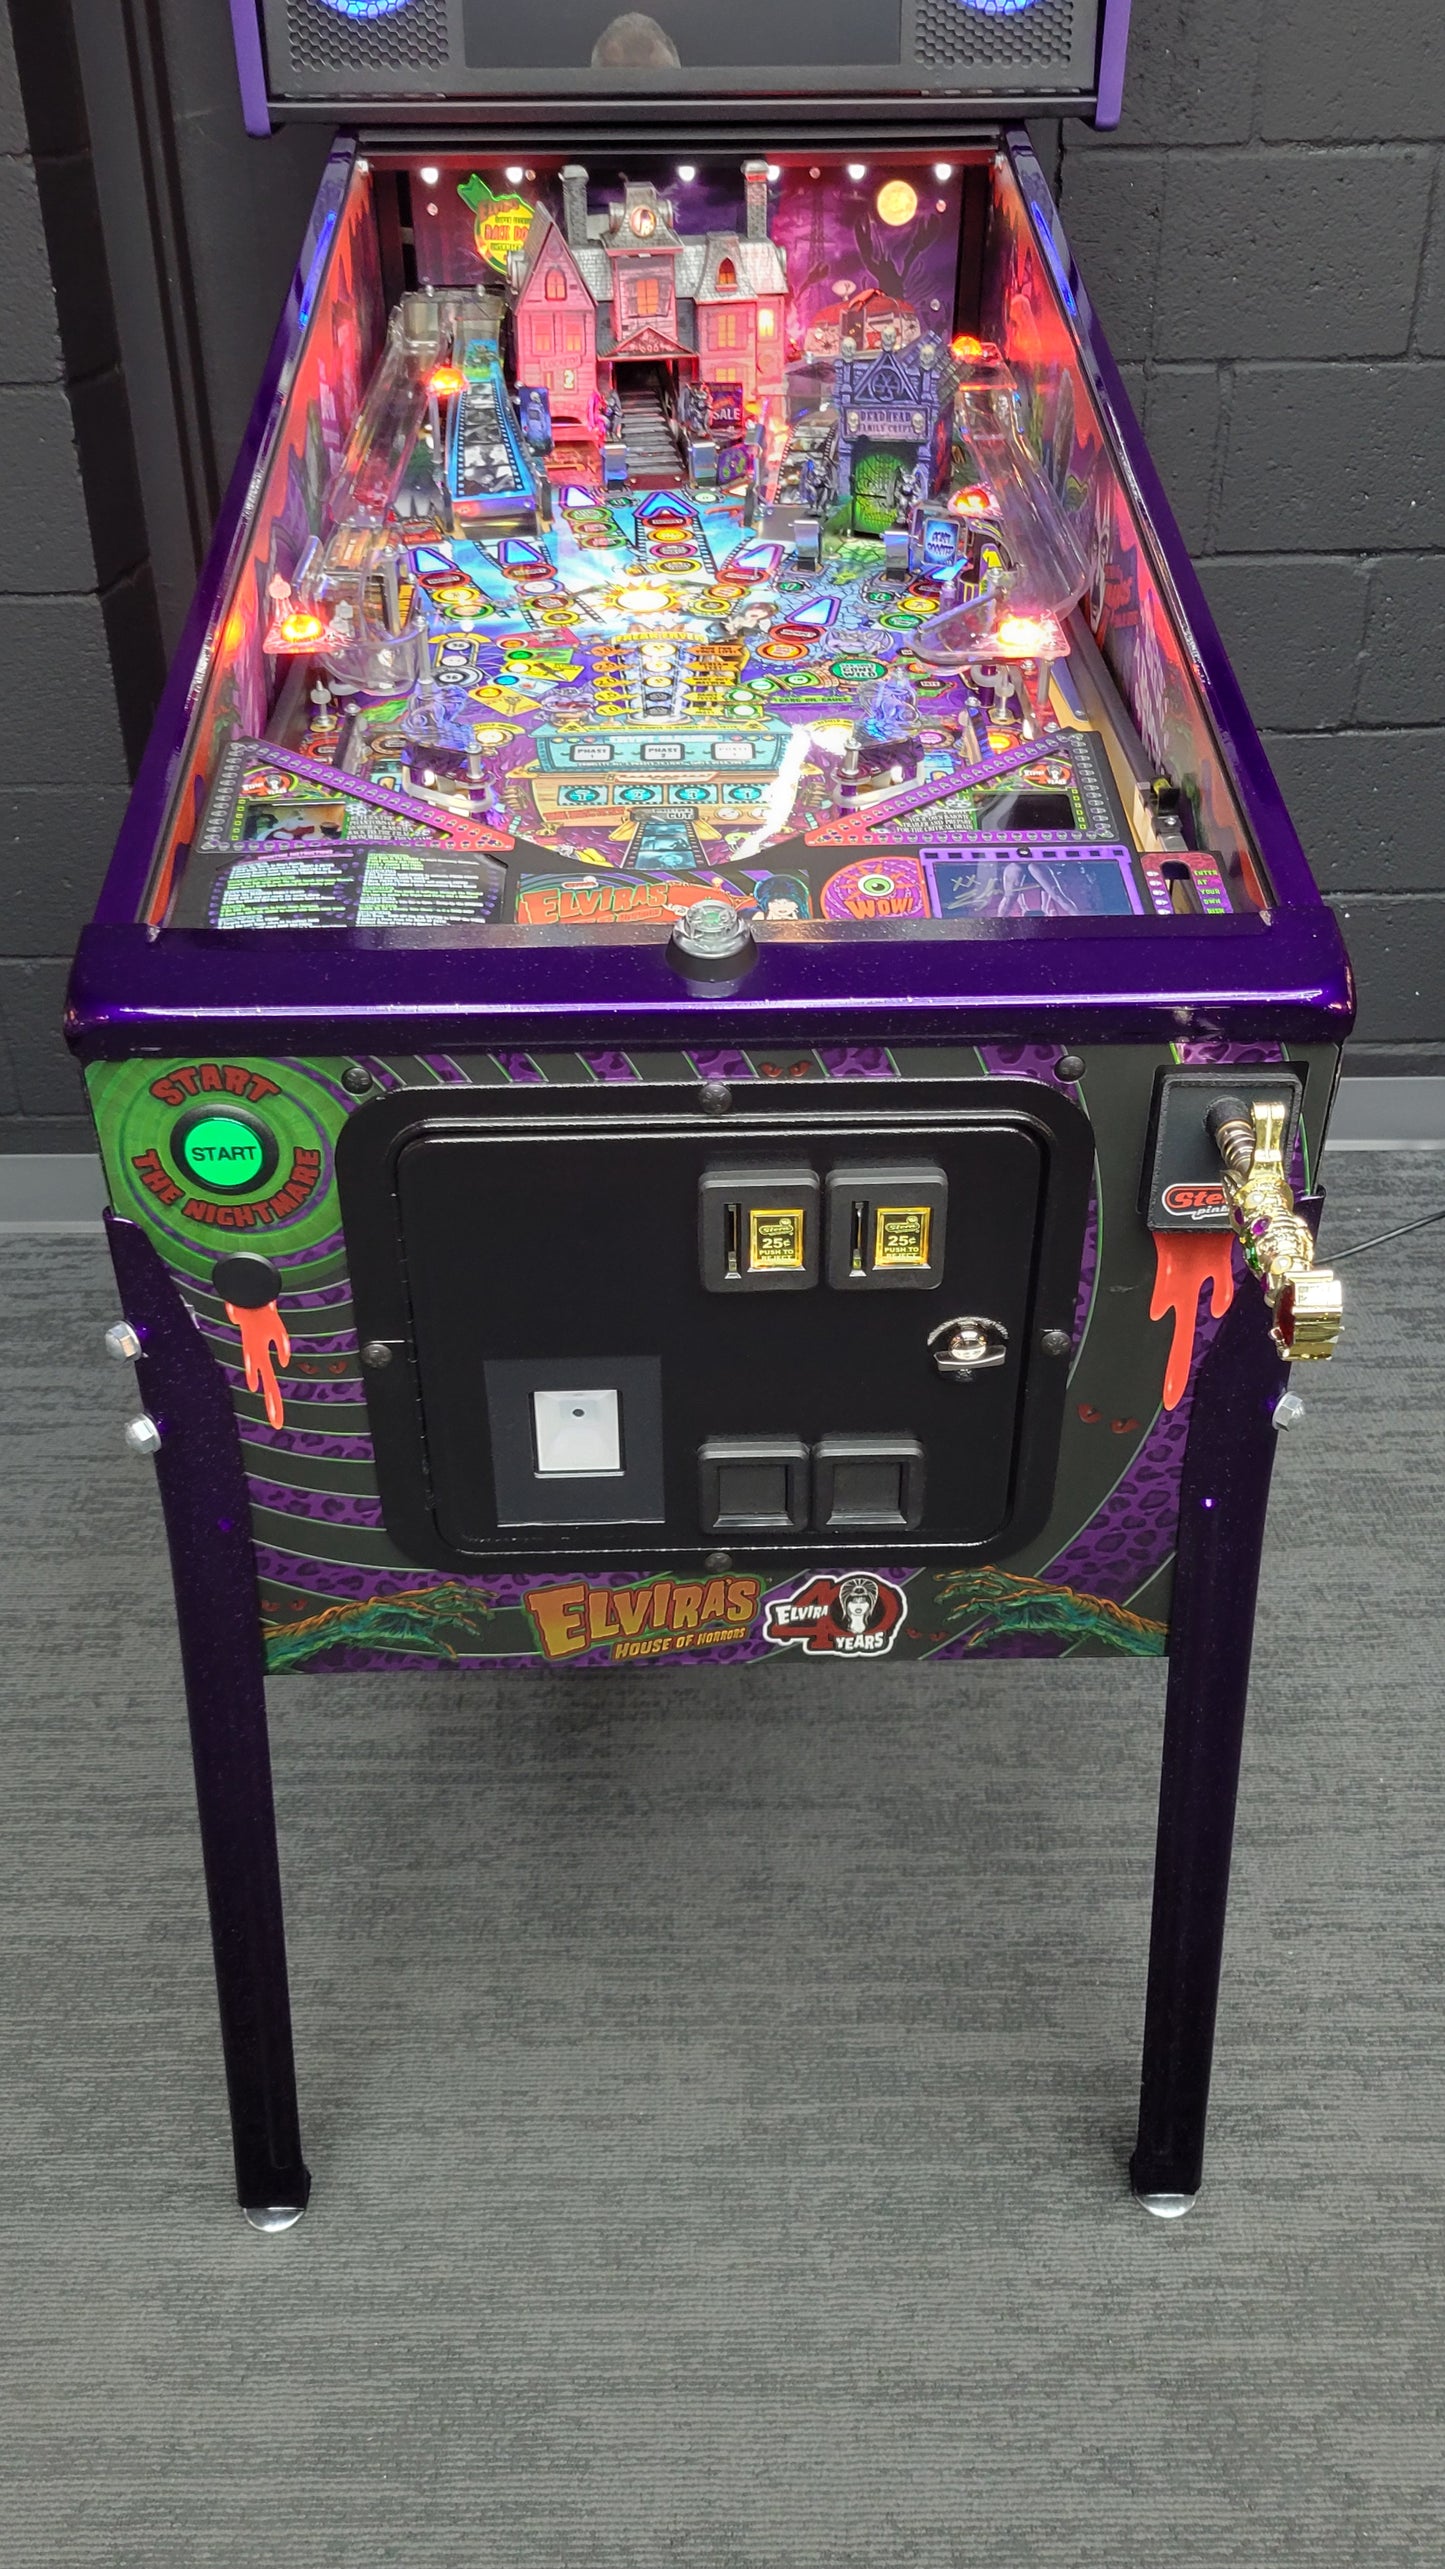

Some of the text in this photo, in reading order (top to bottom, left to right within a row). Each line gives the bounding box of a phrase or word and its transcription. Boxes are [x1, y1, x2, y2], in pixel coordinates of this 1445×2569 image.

[713, 408, 741, 420] SALE
[844, 898, 913, 919] WOW!
[149, 1064, 282, 1106] START
[191, 1146, 257, 1162] START
[131, 1146, 321, 1228] THE NIGHTMARE
[1173, 1189, 1226, 1209] Ste
[762, 1238, 791, 1249] 25¢
[888, 1235, 917, 1246] 25¢
[528, 1578, 758, 1658] ELVIRA'S
[775, 1604, 829, 1625] ELVIRA
[614, 1627, 746, 1659] HOUSE OF HORRORS
[835, 1631, 885, 1651] YEARS
